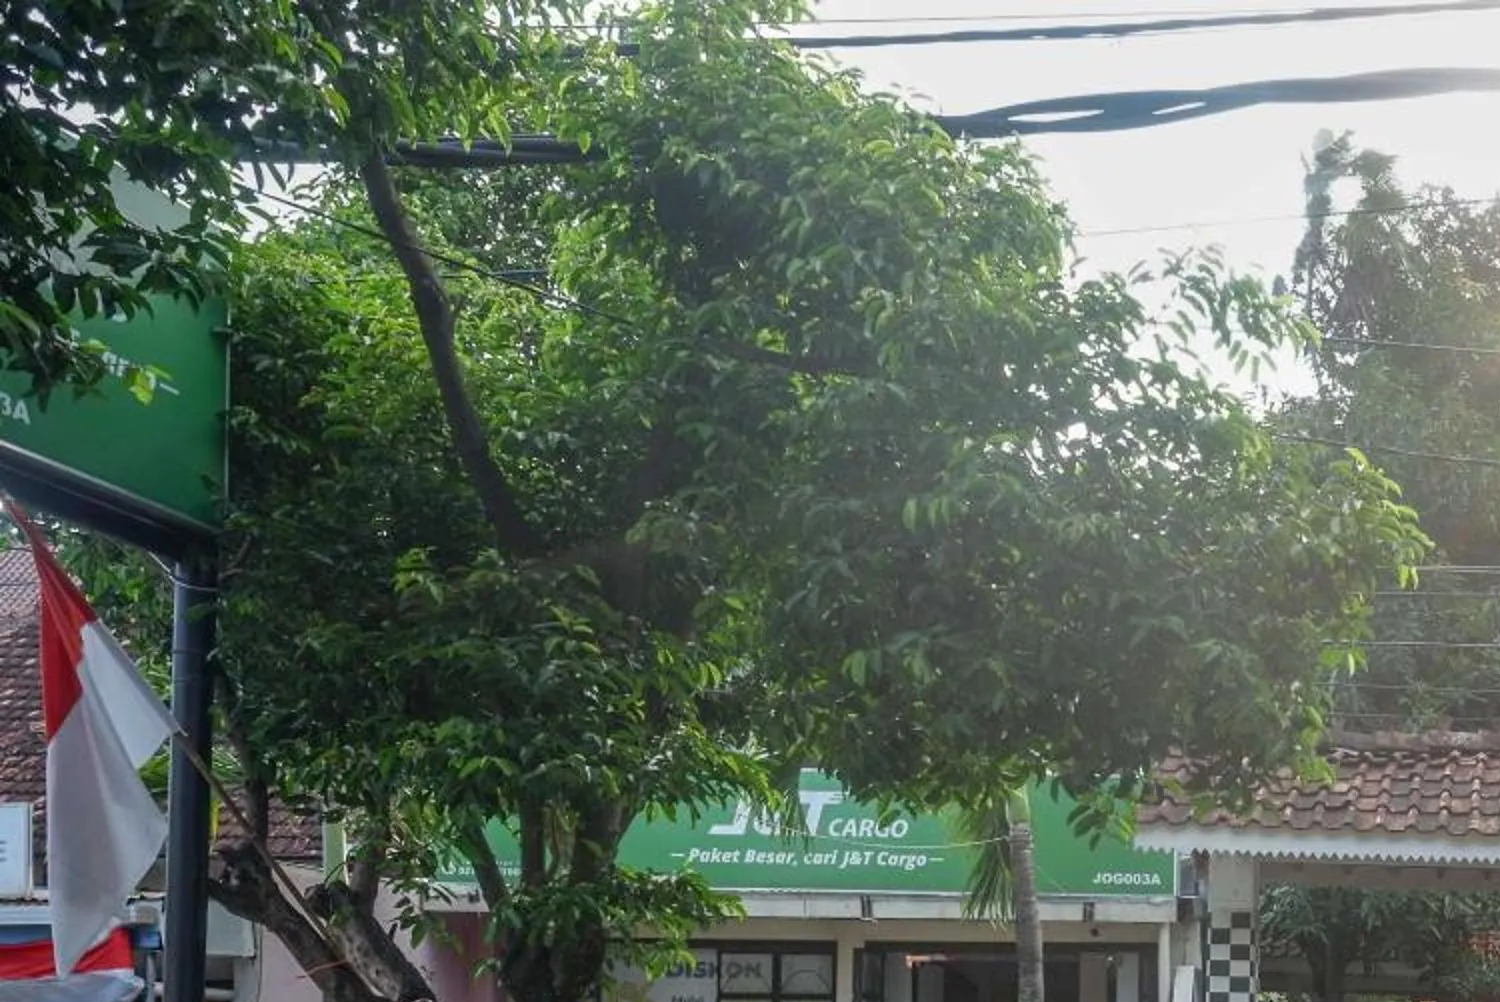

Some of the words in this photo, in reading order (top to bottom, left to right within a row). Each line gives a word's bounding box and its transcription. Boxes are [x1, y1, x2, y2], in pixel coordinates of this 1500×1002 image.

[828, 818, 909, 838] CARGO
[689, 847, 739, 865] Paket
[744, 849, 798, 867] Besar,
[803, 849, 838, 866] cari
[840, 850, 872, 869] J&T
[877, 851, 927, 871] Cargo
[1092, 872, 1162, 885] JOG003A
